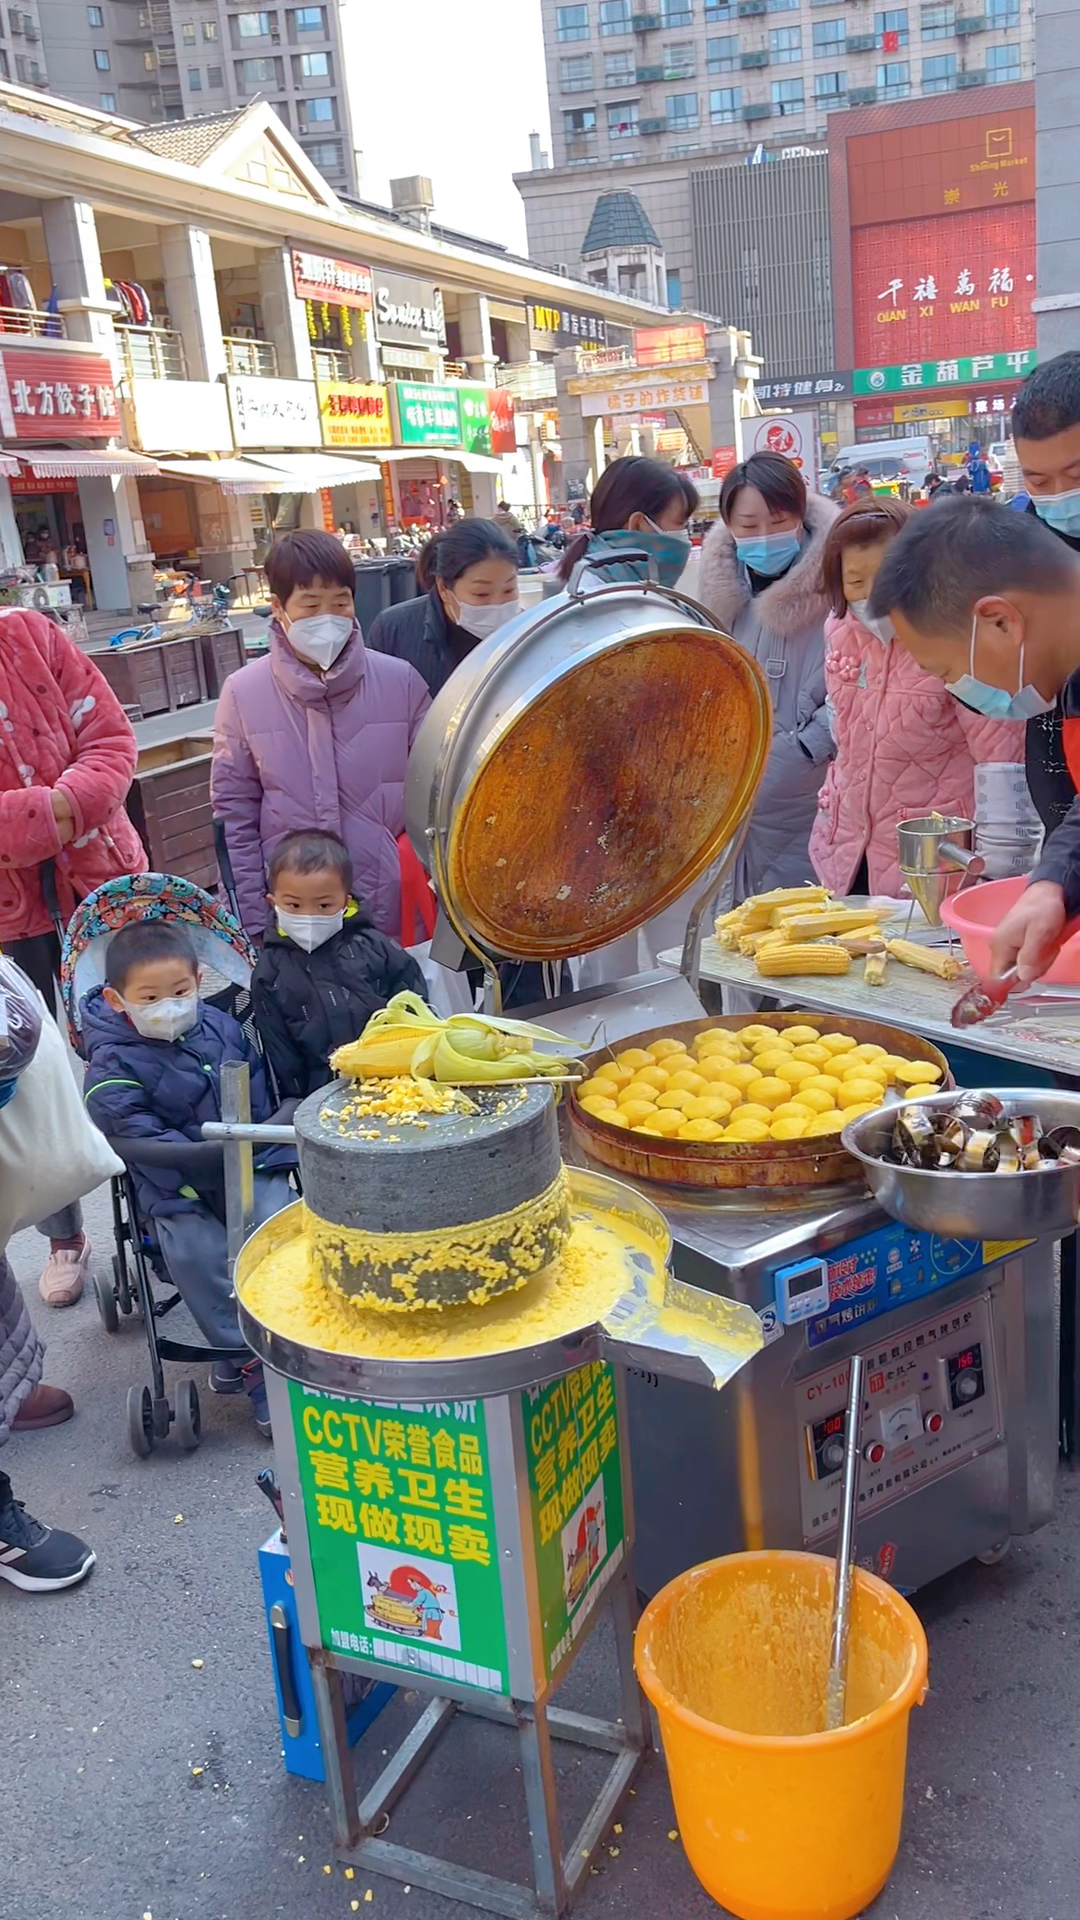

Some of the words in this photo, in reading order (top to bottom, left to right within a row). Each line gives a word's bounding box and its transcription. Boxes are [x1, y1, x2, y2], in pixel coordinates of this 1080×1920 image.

[1000, 157, 1028, 168] Market
[876, 309, 906, 324] QIAN
[919, 306, 933, 317] XI
[950, 300, 980, 314] WAN
[991, 296, 1009, 308] FU
[303, 1405, 483, 1476] CCTV荣誉食品
[534, 1373, 615, 1501] 营养卫生
[309, 1450, 487, 1520] 营养卫生
[538, 1414, 617, 1546] 现做现卖
[315, 1493, 491, 1567] 现做现卖
